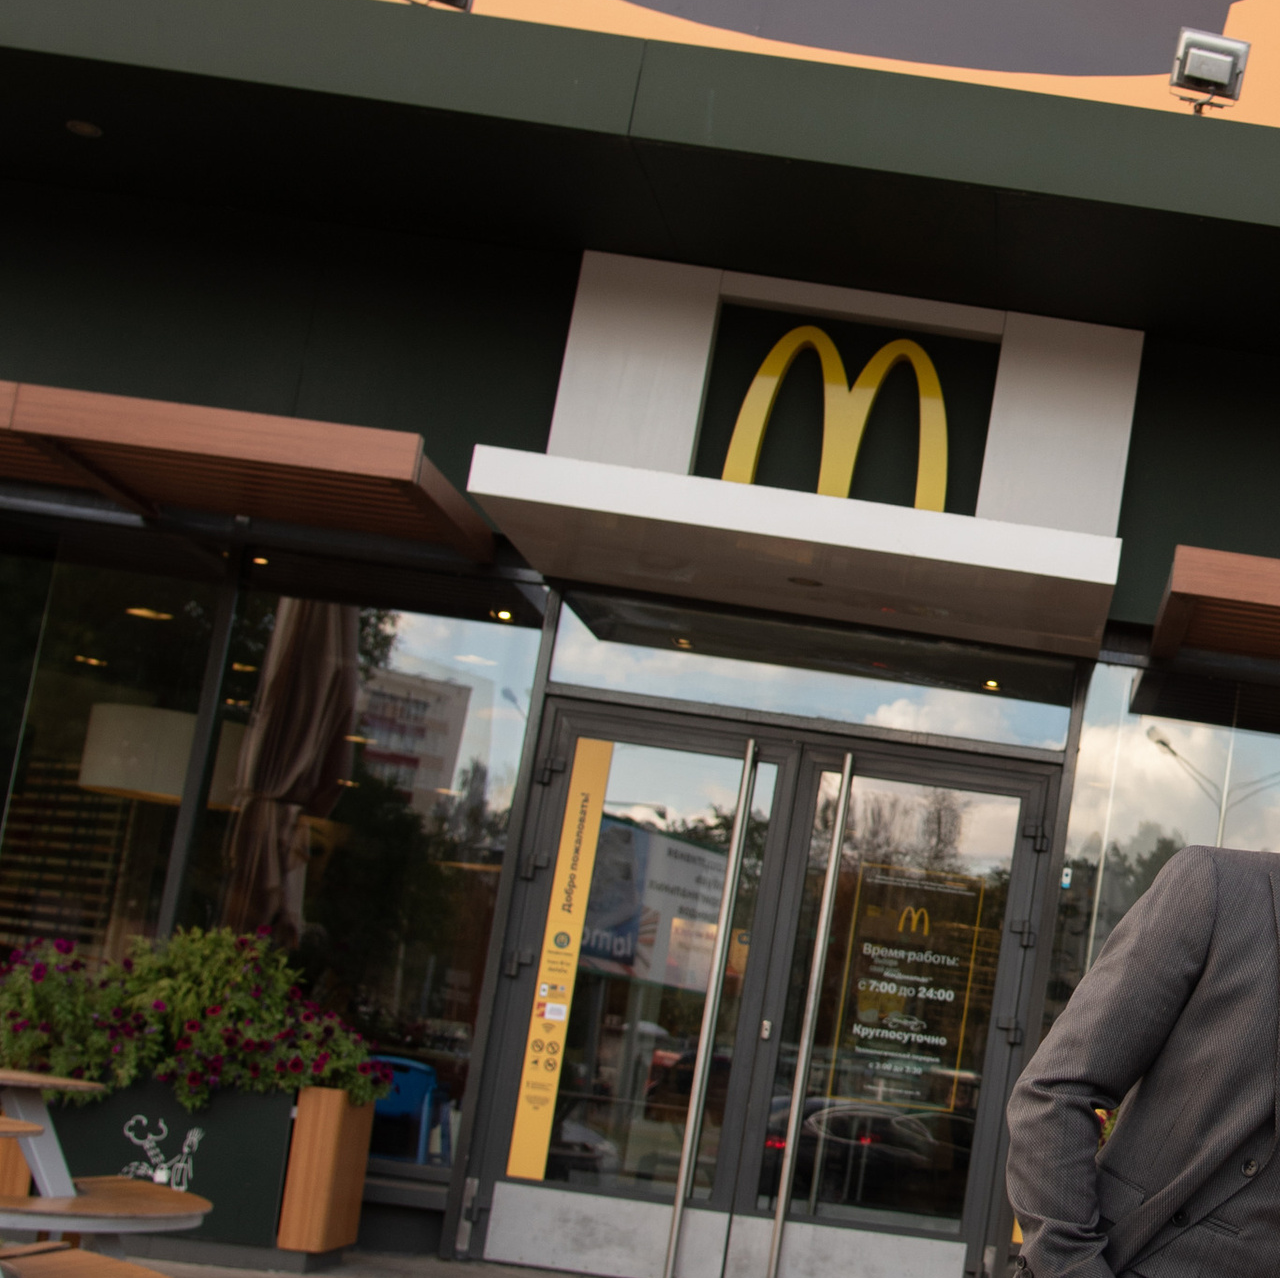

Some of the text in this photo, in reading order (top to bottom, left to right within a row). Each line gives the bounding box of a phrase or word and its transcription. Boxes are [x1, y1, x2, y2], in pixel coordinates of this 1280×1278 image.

[561, 792, 591, 914] Добро пожаловать!
[862, 942, 906, 960] Время
[906, 950, 960, 967] работы:
[868, 979, 897, 994] 7:00
[898, 985, 916, 997] до
[917, 986, 955, 1002] 24:00
[852, 1023, 948, 1046] Круглосуточно
